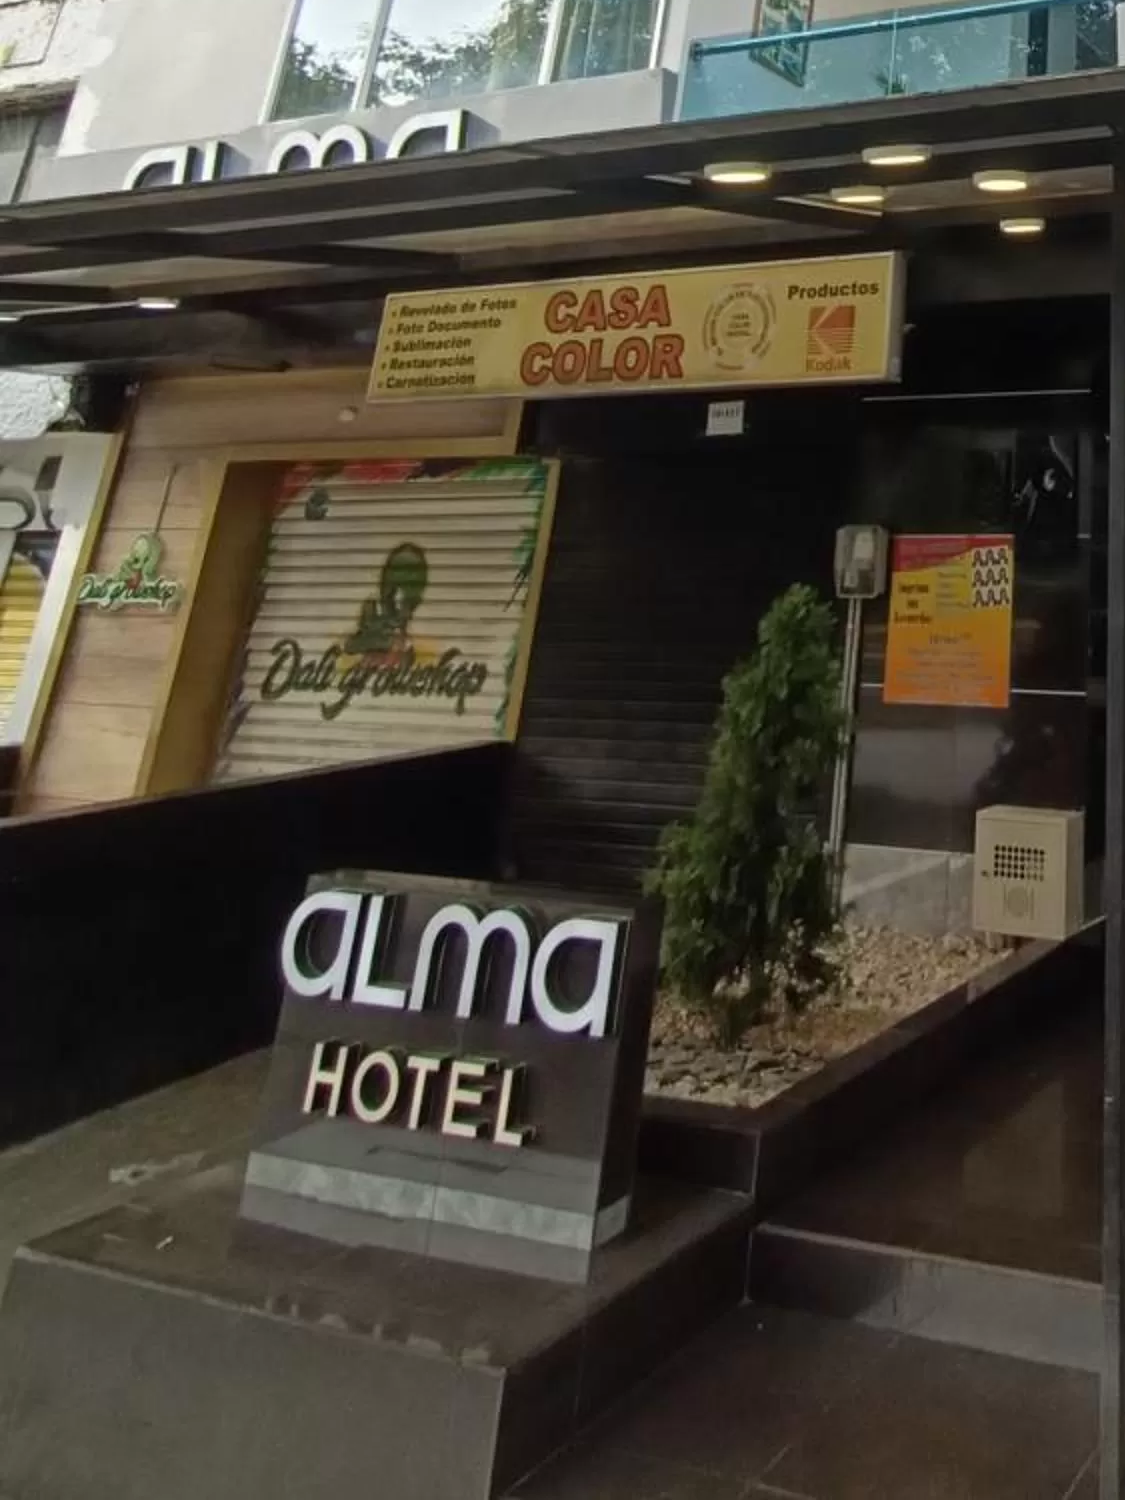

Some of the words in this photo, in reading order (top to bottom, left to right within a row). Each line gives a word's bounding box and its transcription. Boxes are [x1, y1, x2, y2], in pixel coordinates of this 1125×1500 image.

[544, 284, 671, 333] CASA
[787, 281, 880, 300] Productos
[520, 333, 684, 386] COLOR
[806, 356, 852, 372] Kodak
[302, 1041, 530, 1147] HOTEL
